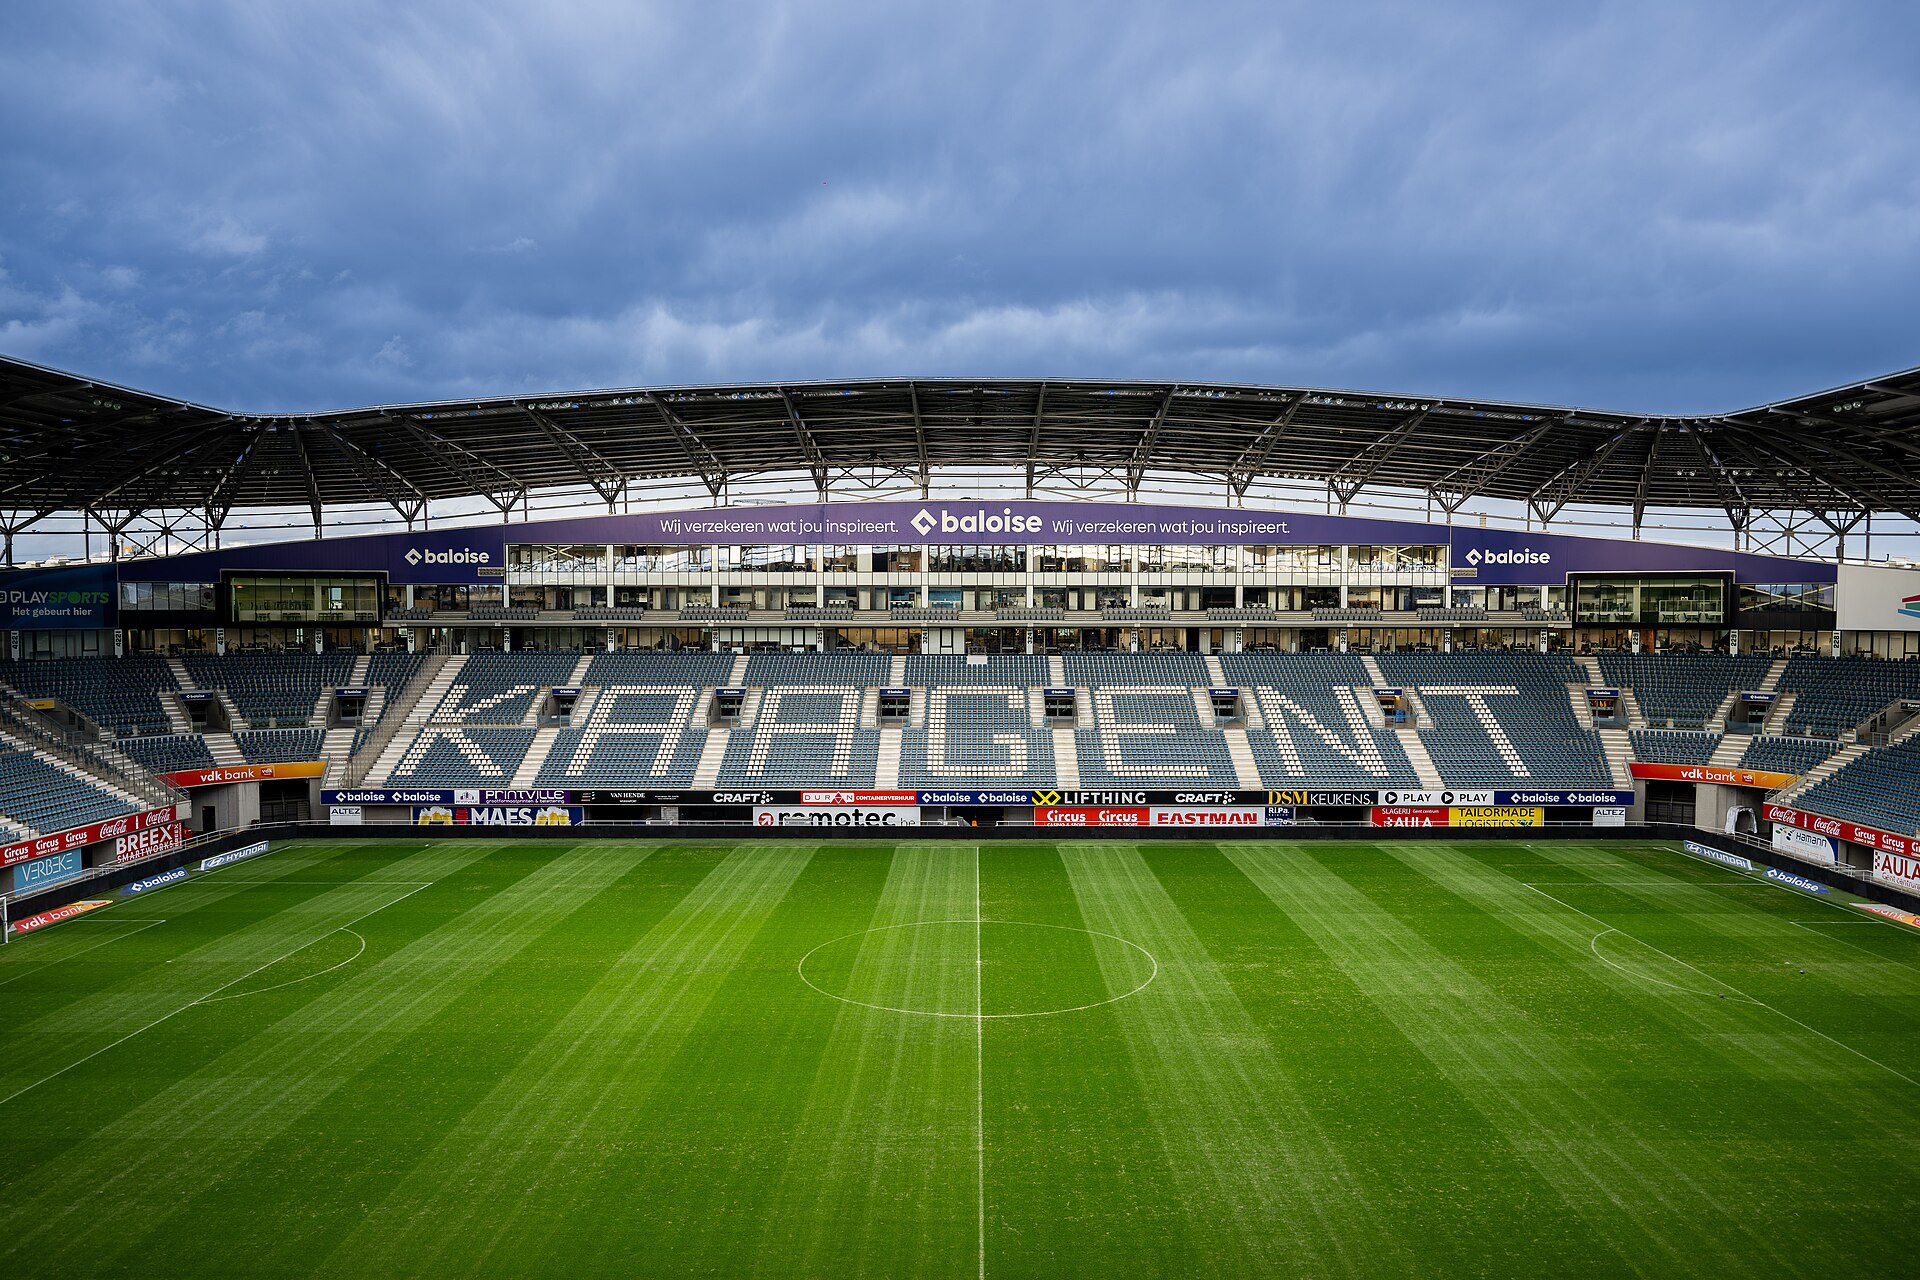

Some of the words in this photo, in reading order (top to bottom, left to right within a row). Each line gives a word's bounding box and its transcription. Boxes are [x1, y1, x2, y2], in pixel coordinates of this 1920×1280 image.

[660, 519, 681, 535] Wij
[684, 519, 764, 533] verzekeren
[768, 520, 796, 533] wat
[798, 519, 822, 536] jou
[826, 519, 898, 536] inspireert.
[941, 508, 1042, 533] baloise
[1052, 520, 1074, 536] Wij
[1076, 520, 1156, 534] verzekeren
[1160, 522, 1188, 534] wat
[1190, 520, 1214, 536] jou
[1218, 520, 1290, 536] inspireert.
[424, 548, 490, 564] baloise
[1484, 548, 1551, 564] baloise
[12, 607, 30, 616] Het
[32, 607, 70, 618] gebeurt
[74, 607, 92, 616] hier
[200, 770, 222, 782] vdk
[225, 768, 254, 780] bank
[1681, 768, 1703, 779] vdk
[1706, 770, 1736, 782] bank
[347, 791, 385, 801] baloise
[403, 791, 441, 801] baloise
[713, 793, 760, 802] CRAFT
[932, 792, 971, 802] baloise
[989, 792, 1027, 802] baloise
[1064, 792, 1146, 804] LIFTHING
[1175, 793, 1222, 802] CRAFT
[1268, 791, 1308, 804] DSM
[1311, 793, 1374, 805] KEUKENS.
[1522, 793, 1560, 802] baloise
[1578, 793, 1616, 802] baloise
[471, 808, 532, 825] MAES
[1047, 810, 1086, 822] Circus
[1098, 810, 1138, 822] Circus
[1158, 813, 1257, 824] EASTMAN
[1459, 808, 1534, 817] TAILORMADE
[66, 832, 87, 842] Circus
[116, 824, 172, 855] BREEX
[1796, 832, 1827, 848] Hamann
[1854, 828, 1875, 840] Circus
[1882, 834, 1904, 848] Circus
[36, 839, 59, 850] Circus
[4, 847, 28, 858] Circus
[117, 840, 173, 864] SMARTWORKS
[226, 844, 266, 861] HYUNDAI
[1704, 849, 1746, 868] HYUNDAI
[22, 853, 72, 882] VERBEKE
[143, 869, 185, 888] baloise
[1777, 872, 1819, 892] baloise
[21, 916, 48, 930] vdk
[50, 905, 86, 920] bank
